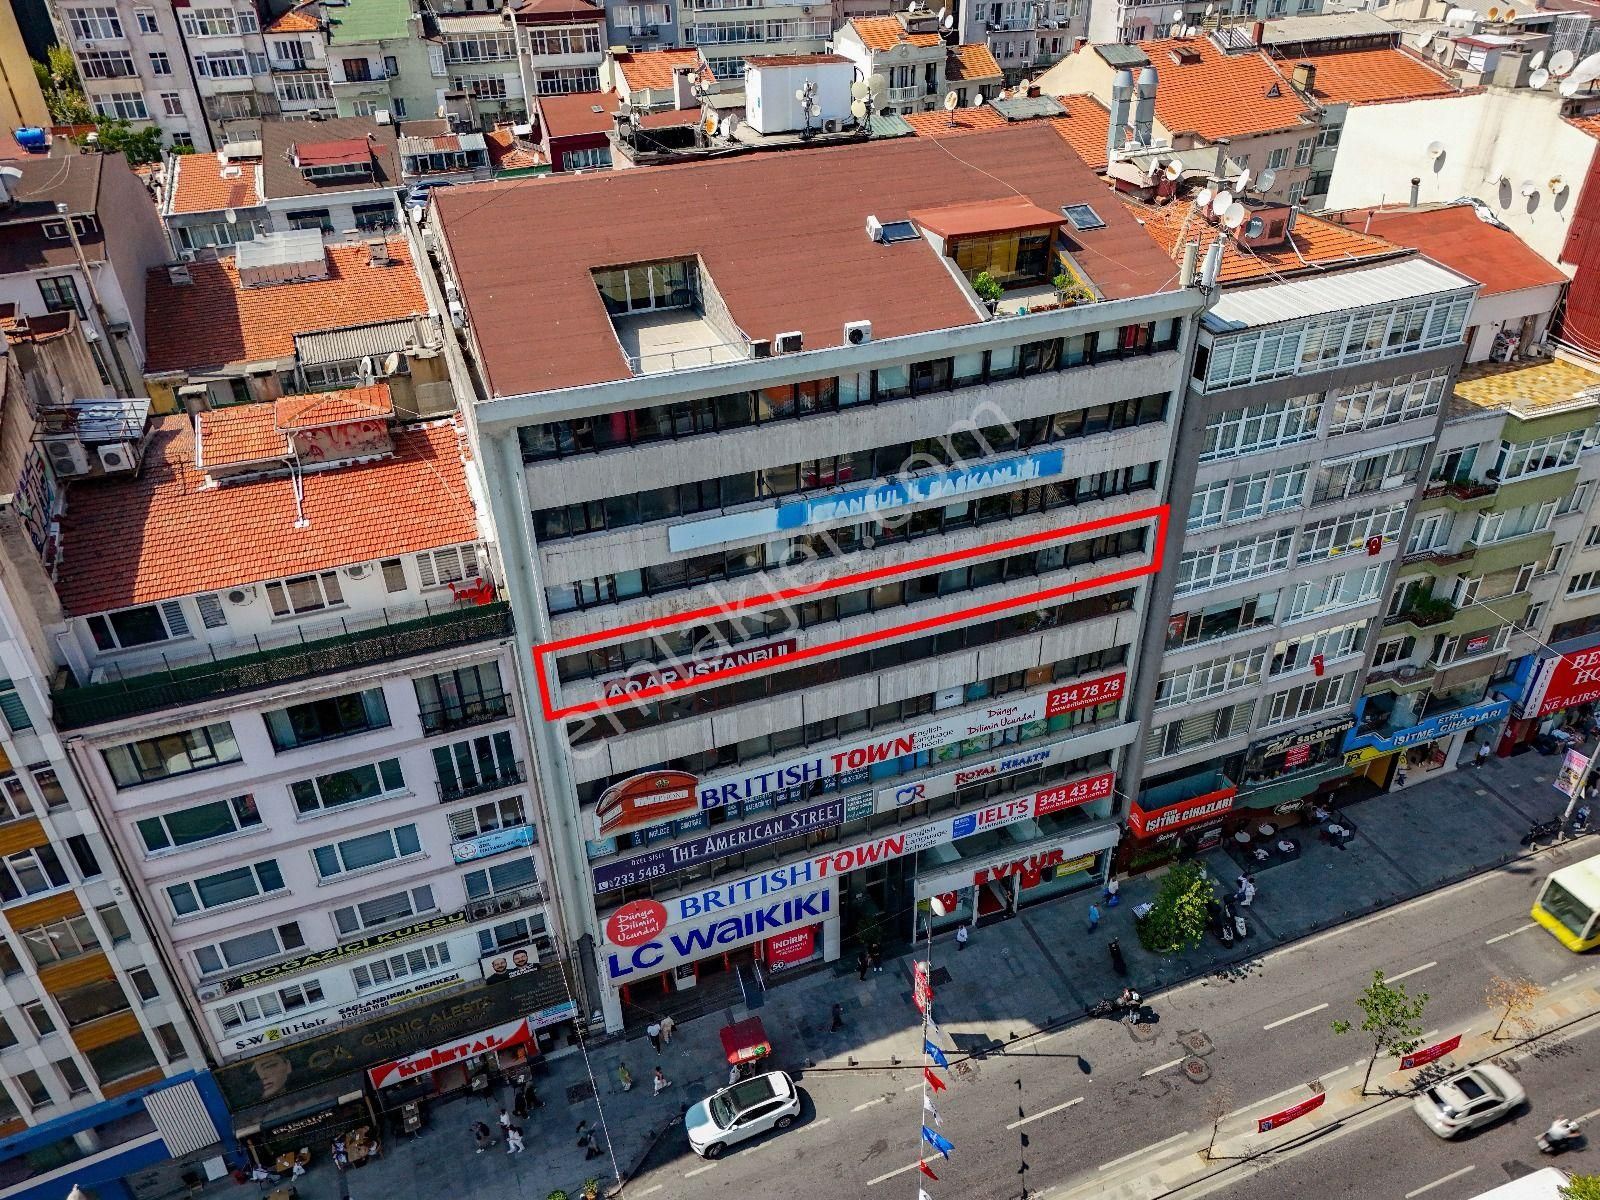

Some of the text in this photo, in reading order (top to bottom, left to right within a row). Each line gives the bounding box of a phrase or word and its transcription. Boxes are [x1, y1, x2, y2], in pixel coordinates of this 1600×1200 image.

[1052, 678, 1121, 707] 234 78 78
[913, 725, 943, 738] English
[701, 759, 822, 811] BRITISH
[831, 734, 914, 774] TOWN
[955, 750, 1051, 785] ROYAL HEALTH
[1039, 778, 1109, 807] 343 43 43
[978, 799, 1029, 826] IELTS
[669, 843, 698, 864] THE
[705, 815, 784, 854] AMERICAN
[790, 803, 843, 829] STREET
[904, 825, 936, 839] English
[904, 828, 949, 846] Language
[904, 839, 937, 853] Schools
[614, 863, 666, 887] 233 5483
[680, 835, 905, 921] BRITISH TOWN
[377, 911, 465, 943] KURSU
[617, 907, 655, 925] Dünya
[617, 917, 656, 933] Dilimin
[608, 942, 665, 979] LC
[293, 1017, 328, 1033] Hair
[361, 1017, 425, 1047] CLINIC
